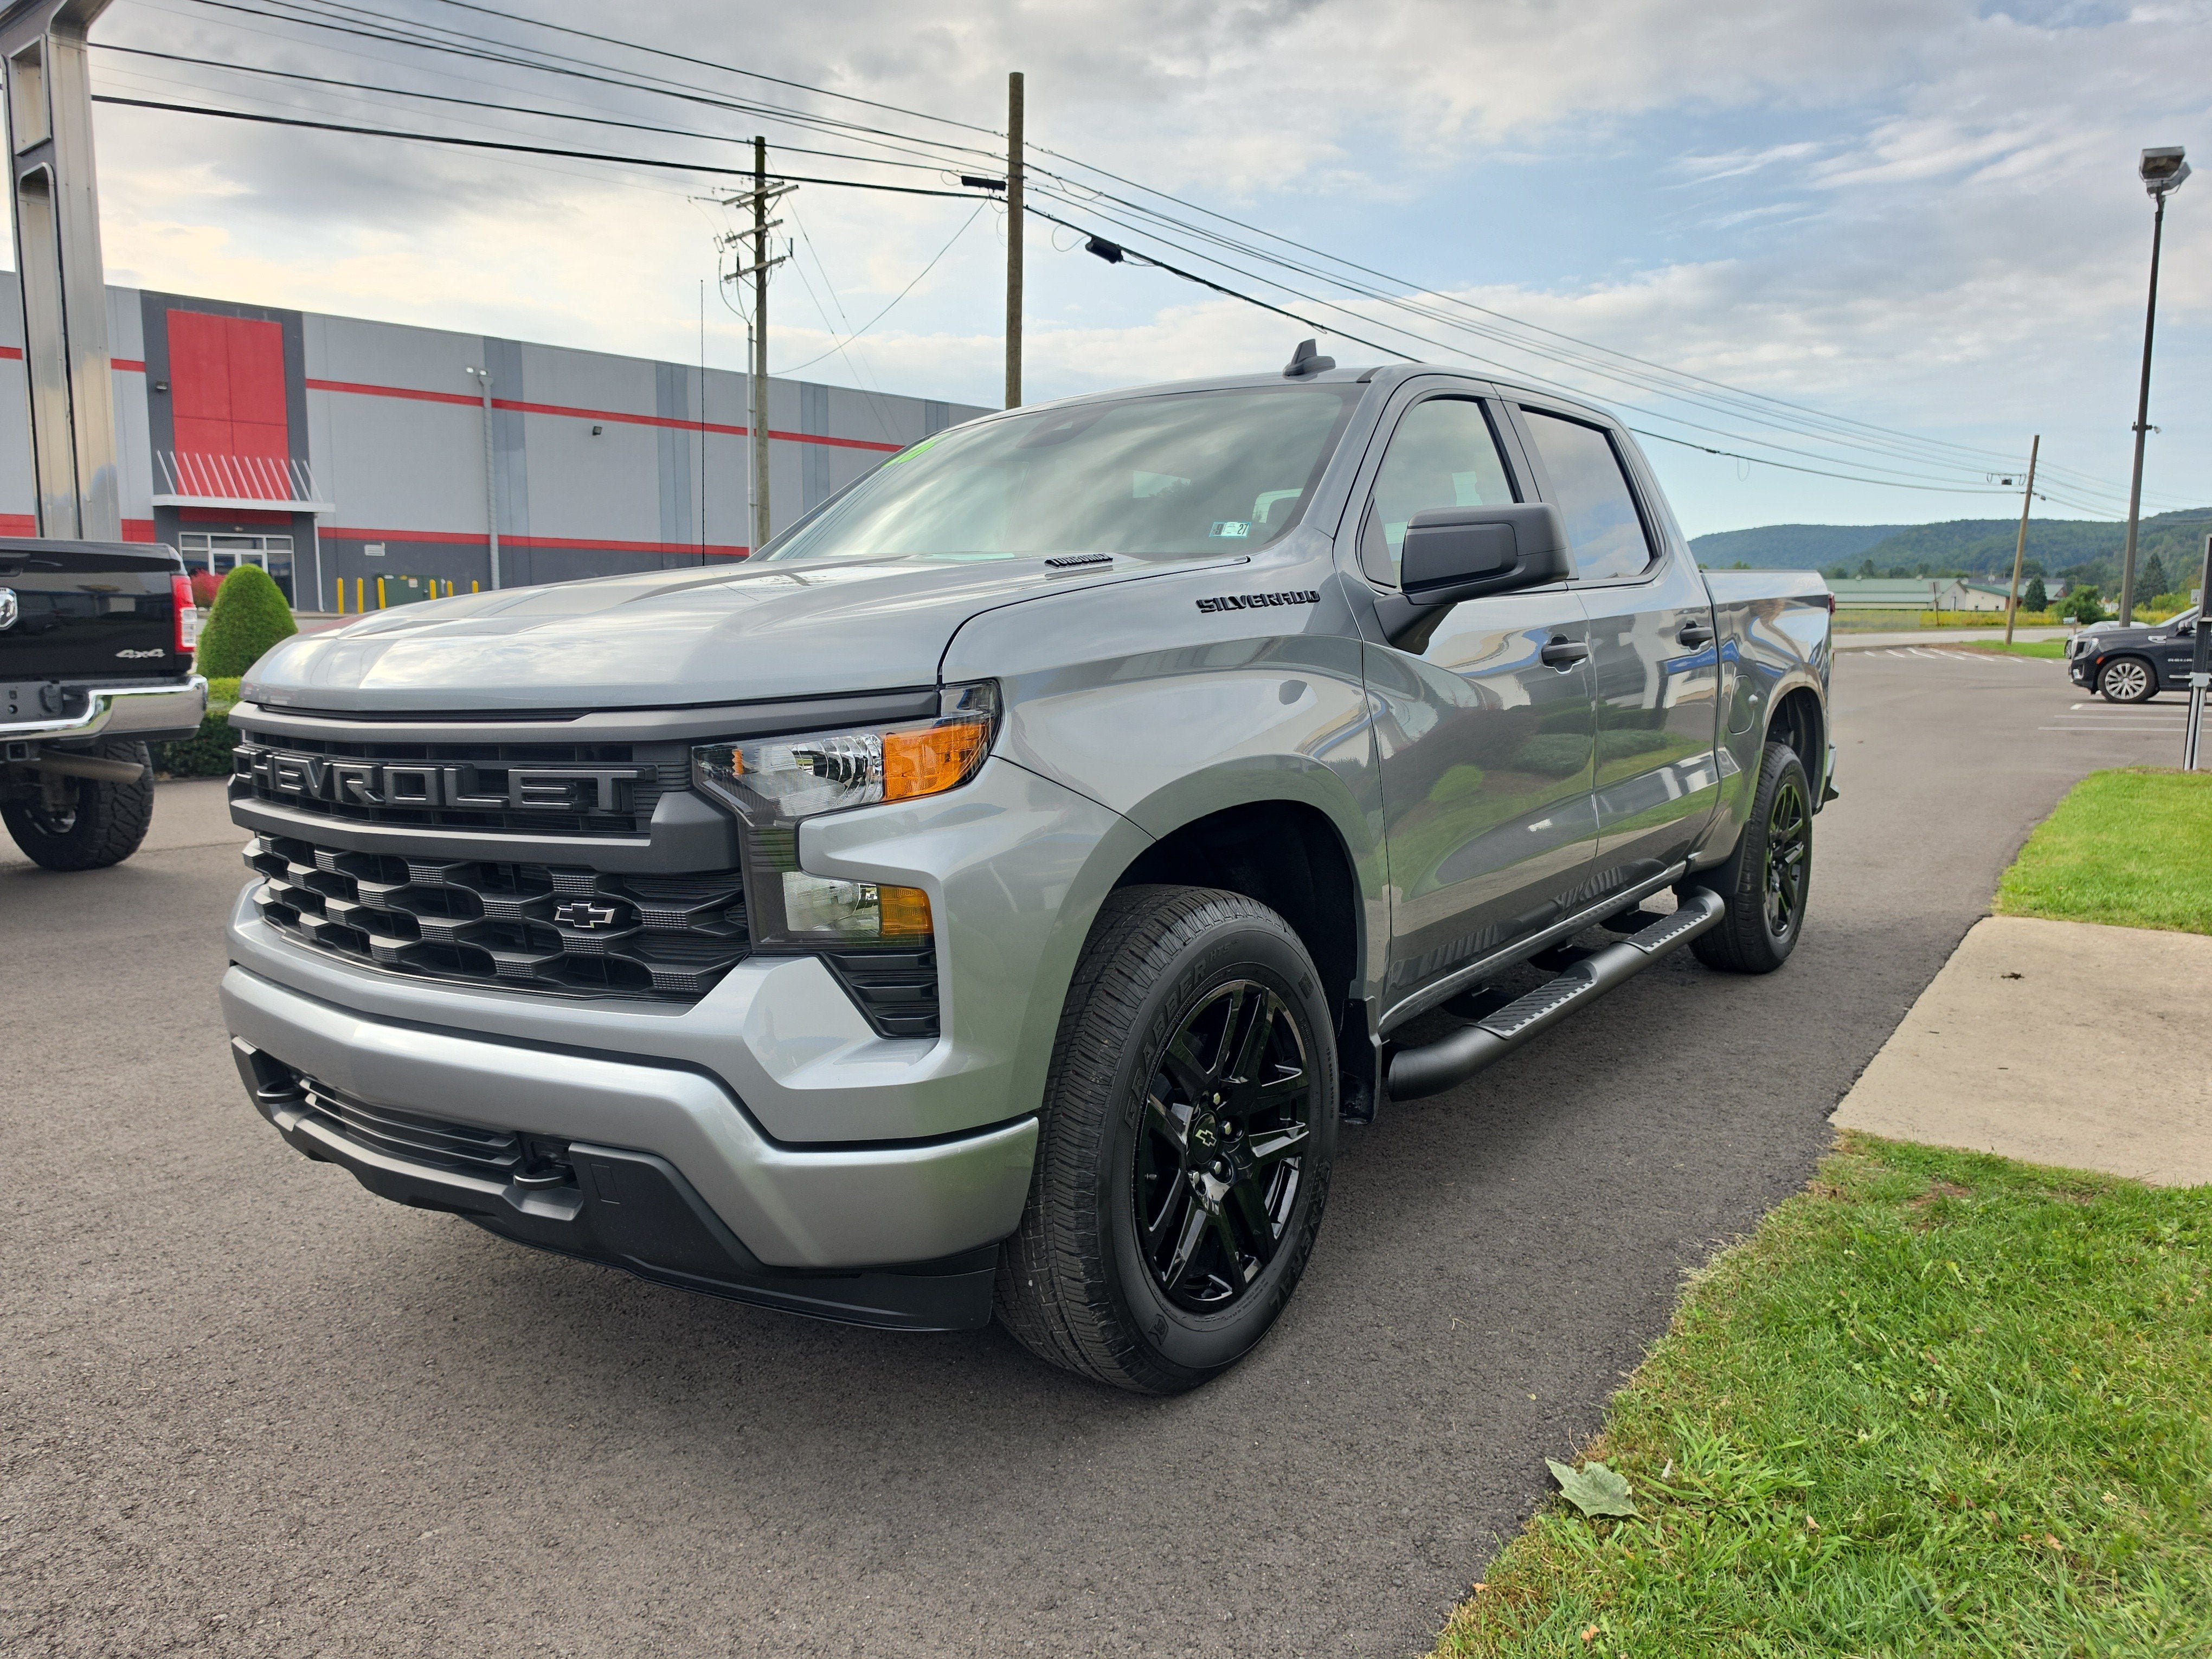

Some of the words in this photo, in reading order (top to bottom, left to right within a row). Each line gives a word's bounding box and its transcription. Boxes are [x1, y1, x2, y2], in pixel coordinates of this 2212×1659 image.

[1237, 524, 1248, 535] 27
[1045, 552, 1113, 567] TURBOMAX
[1195, 590, 1321, 613] SILVERADO
[232, 744, 655, 813] CHEVROLET
[1124, 958, 1207, 1129] GRABBER
[1269, 1158, 1332, 1310] GENERAL
